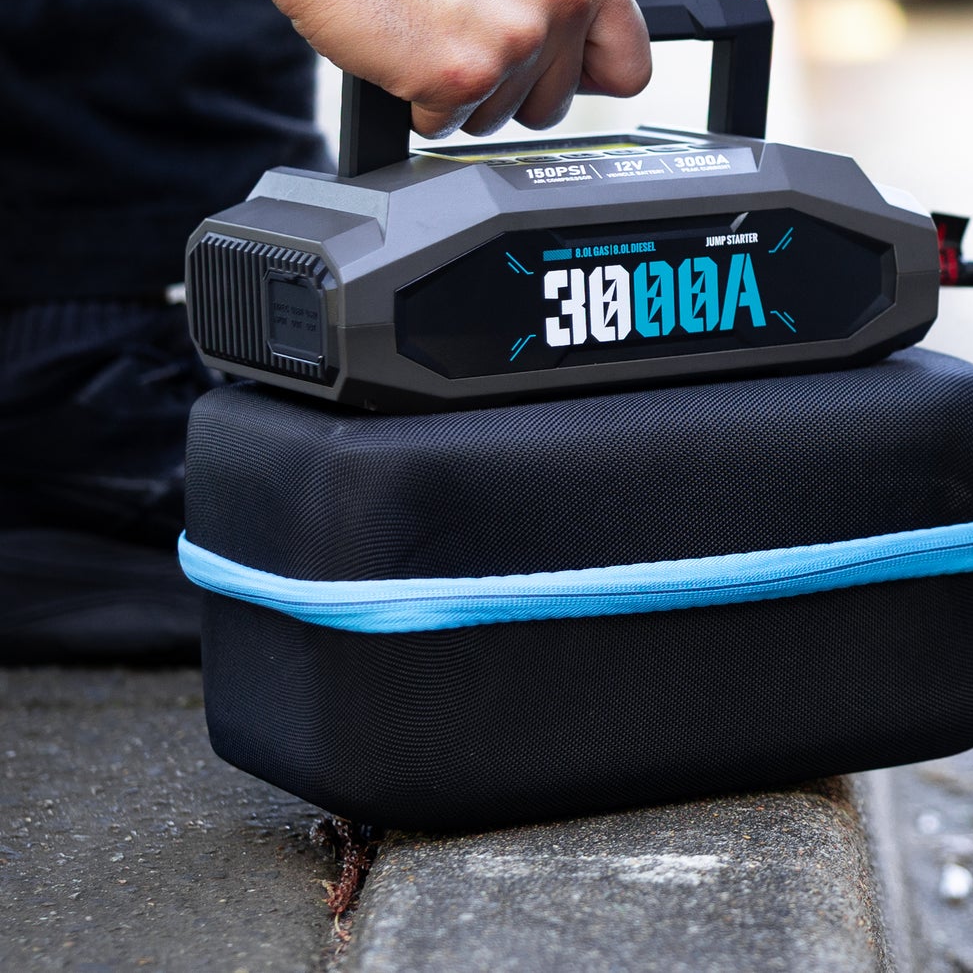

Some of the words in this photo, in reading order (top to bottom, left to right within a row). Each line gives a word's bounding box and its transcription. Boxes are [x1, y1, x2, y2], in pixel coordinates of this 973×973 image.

[614, 159, 643, 172] 12V
[673, 154, 730, 168] 3000A
[526, 164, 587, 179] 150PSI
[705, 235, 726, 247] JUMP
[726, 232, 759, 245] STARTER
[630, 241, 656, 253] DIESEL
[543, 253, 767, 347] 3000A
